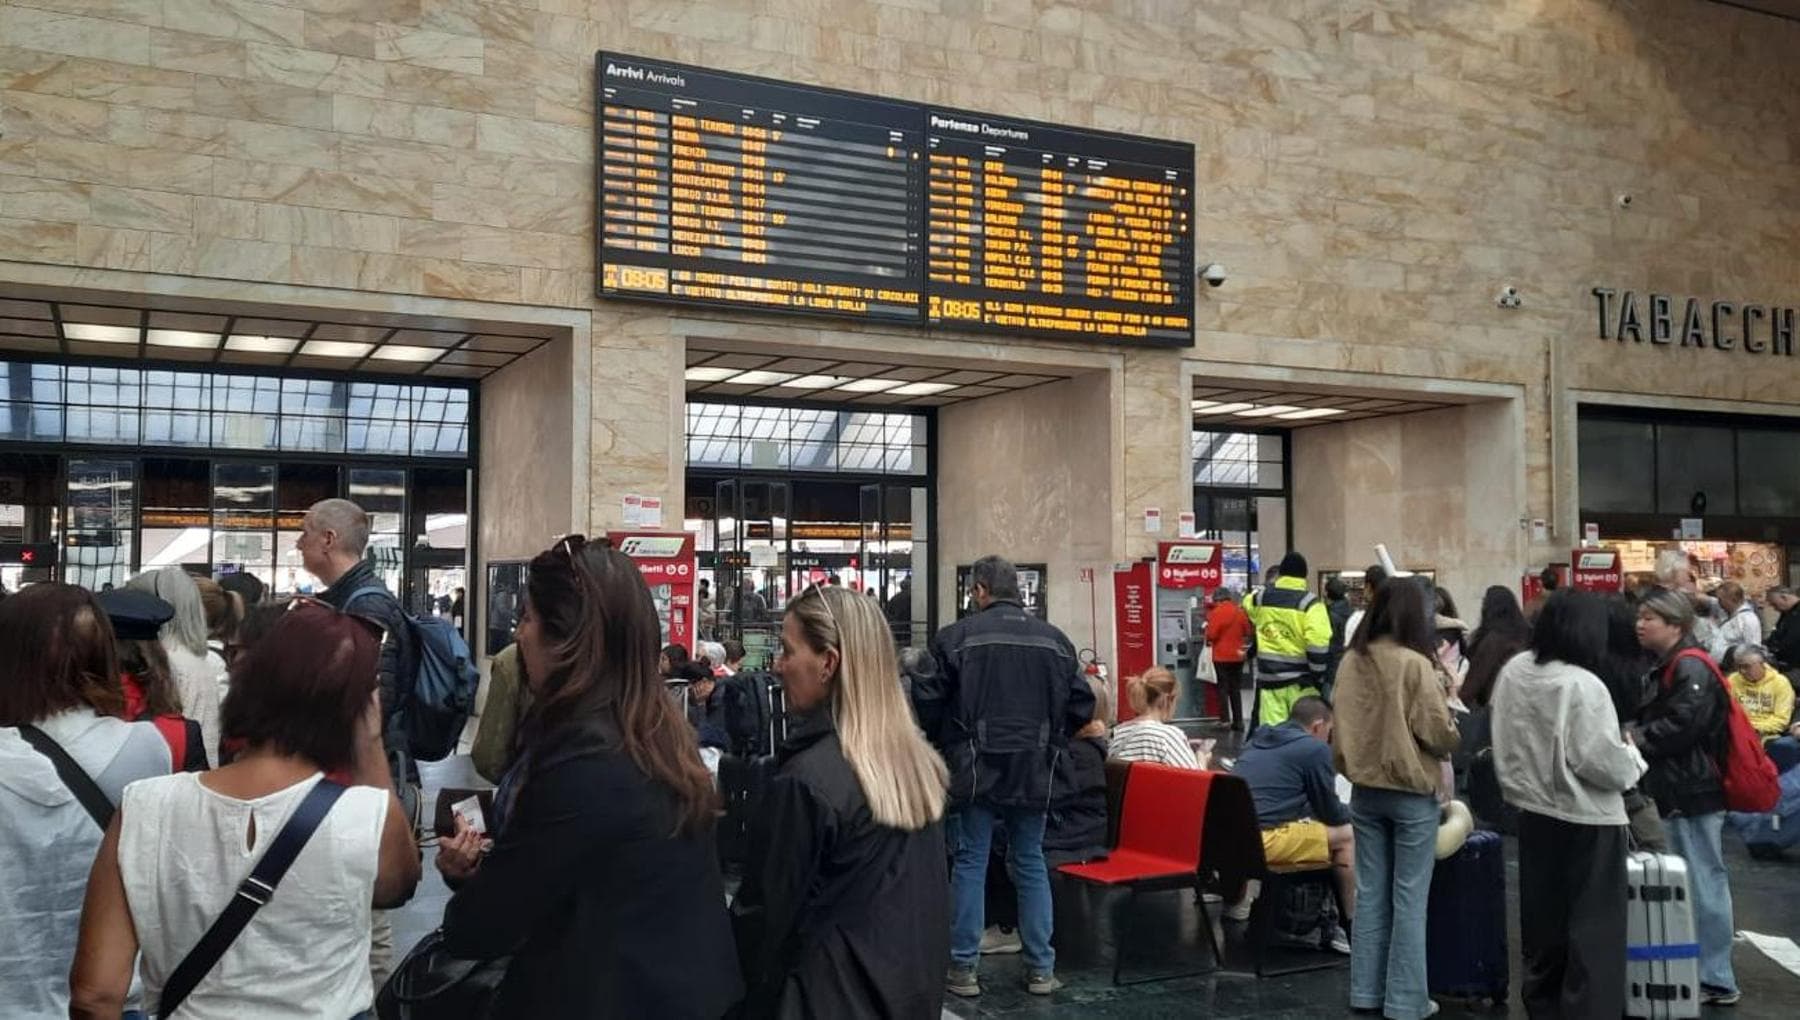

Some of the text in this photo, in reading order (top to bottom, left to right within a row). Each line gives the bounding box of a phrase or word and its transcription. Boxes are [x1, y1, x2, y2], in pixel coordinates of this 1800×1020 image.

[606, 64, 686, 87] Arrivi Arrivals
[981, 123, 1028, 140] Departures
[943, 300, 981, 319] 09:05
[1592, 287, 1794, 356] TABACCH
